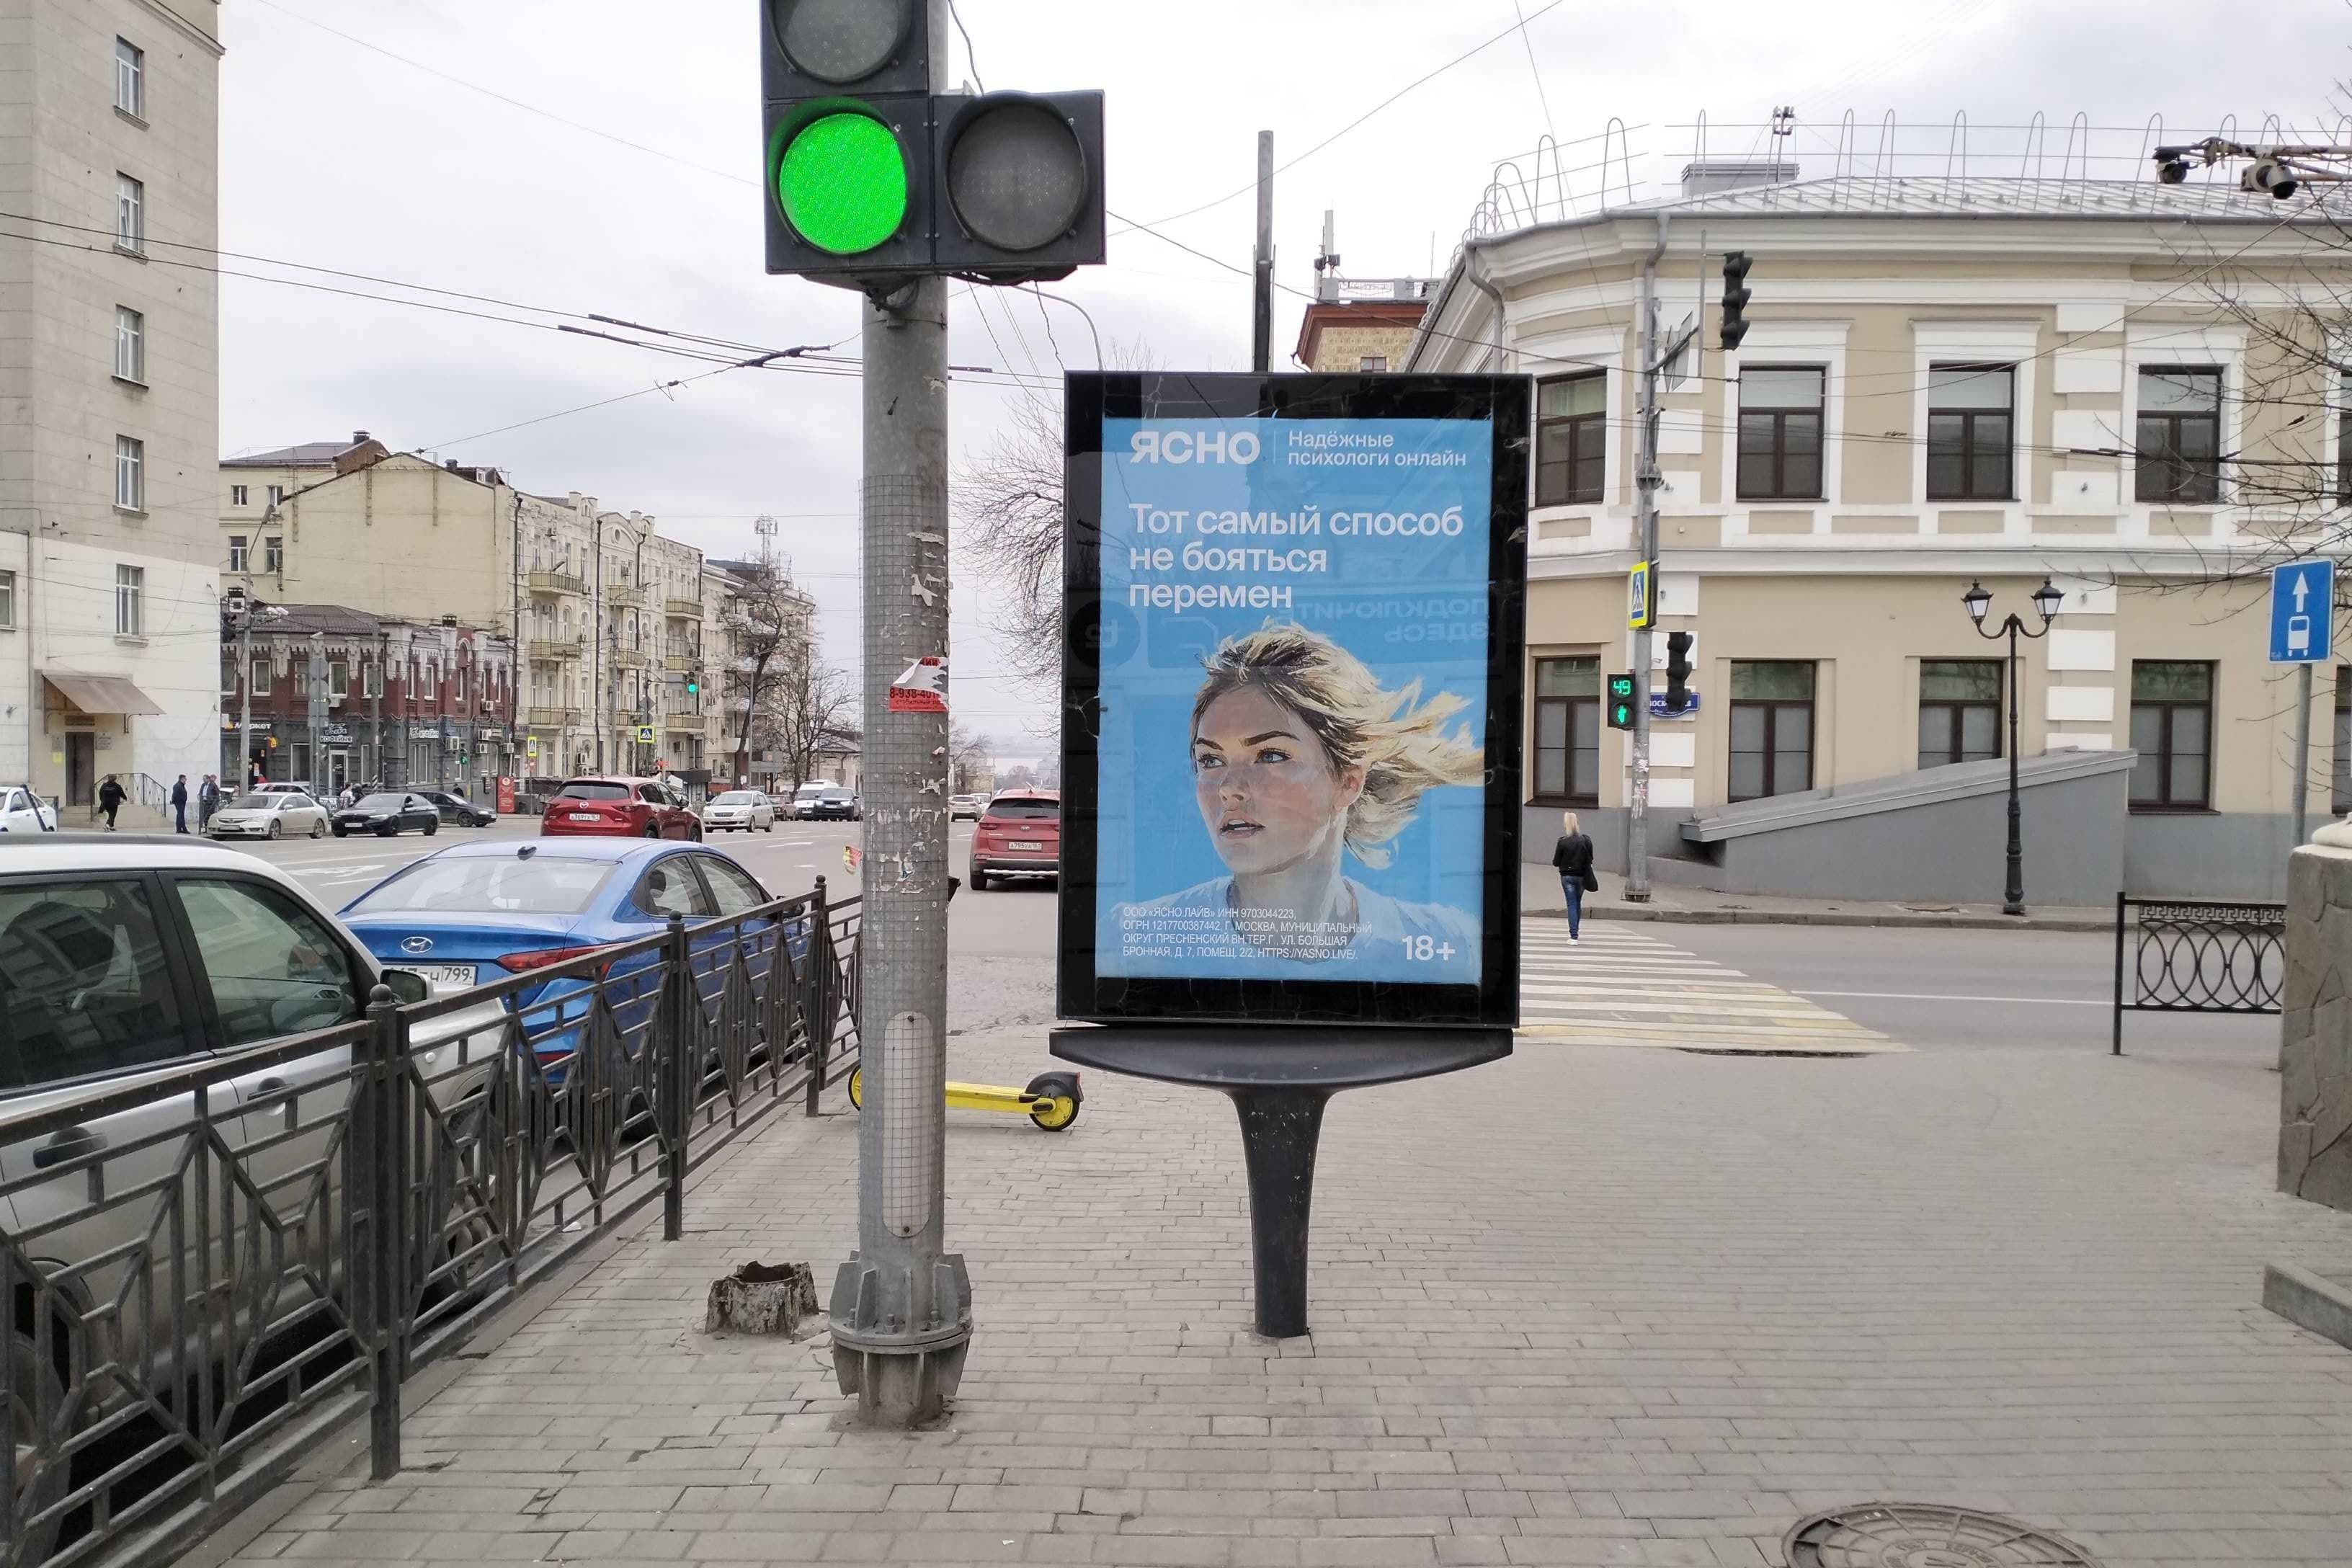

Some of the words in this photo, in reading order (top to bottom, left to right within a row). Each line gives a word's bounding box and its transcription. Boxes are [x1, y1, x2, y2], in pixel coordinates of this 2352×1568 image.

[1130, 431, 1260, 465] ЯСНО
[1288, 431, 1394, 449] Надёжные
[1288, 452, 1389, 466] психологи
[1394, 450, 1466, 466] онлайн
[1129, 503, 1189, 534] Тот
[1196, 504, 1320, 535] самый
[1329, 506, 1464, 536] способ
[1130, 548, 1174, 571] не
[1182, 541, 1327, 572] бояться
[1130, 584, 1291, 613] перемен
[1123, 906, 1146, 917] ООО
[1218, 908, 1239, 918] ИНН
[1123, 920, 1149, 930] ОГРН
[1235, 921, 1278, 932] МОСКВА,
[1280, 922, 1372, 935] МУНИЦИПАЛЬНЫЙ
[1123, 933, 1154, 944] ОКРУГ
[1156, 932, 1229, 944] ПРЕСНЕНСКИЙ
[1280, 935, 1296, 945] УЛ.
[1298, 935, 1347, 946] БОЛЬШАЯ
[1402, 935, 1456, 961] 18+
[444, 967, 470, 981] 799
